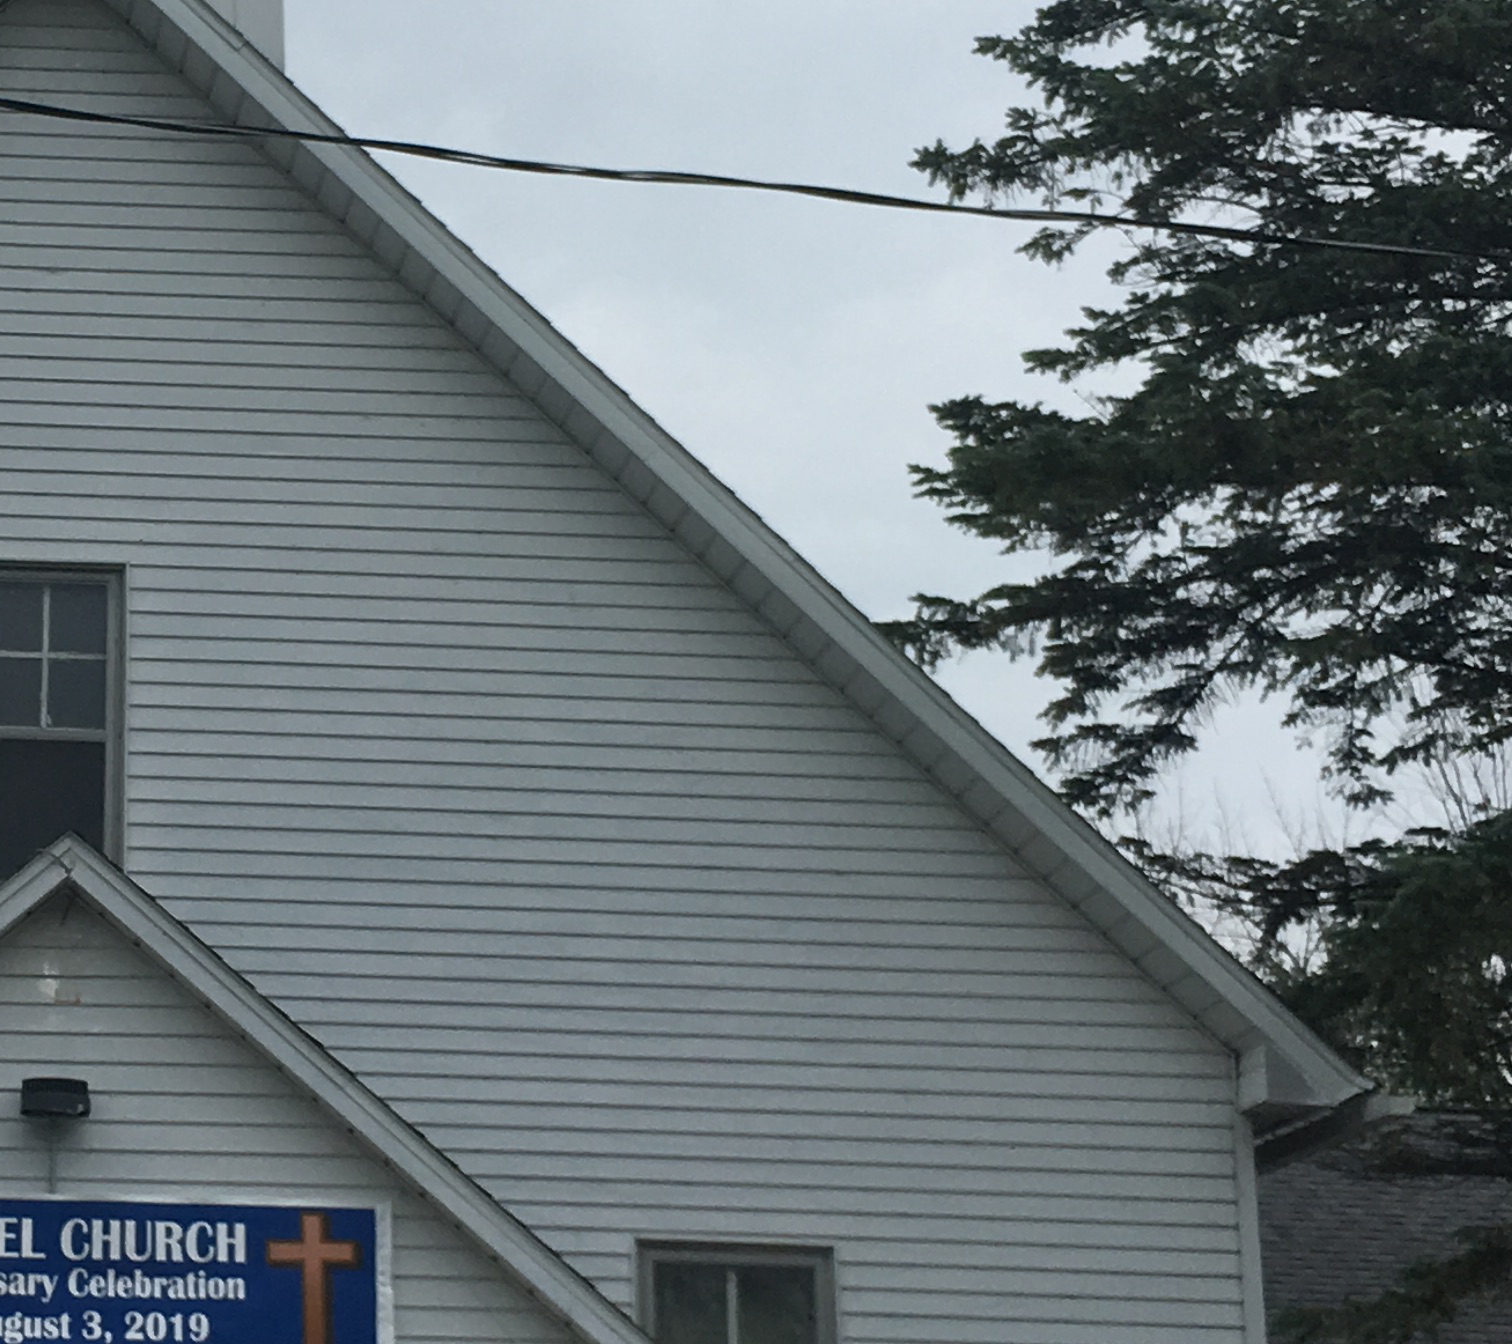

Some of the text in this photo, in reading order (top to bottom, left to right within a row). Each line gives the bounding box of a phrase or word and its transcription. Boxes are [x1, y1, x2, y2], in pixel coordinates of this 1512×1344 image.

[61, 1218, 247, 1265] CHURCH
[68, 1268, 246, 1301] Celebration
[82, 1311, 113, 1343] 3,
[124, 1311, 210, 1343] 2019
